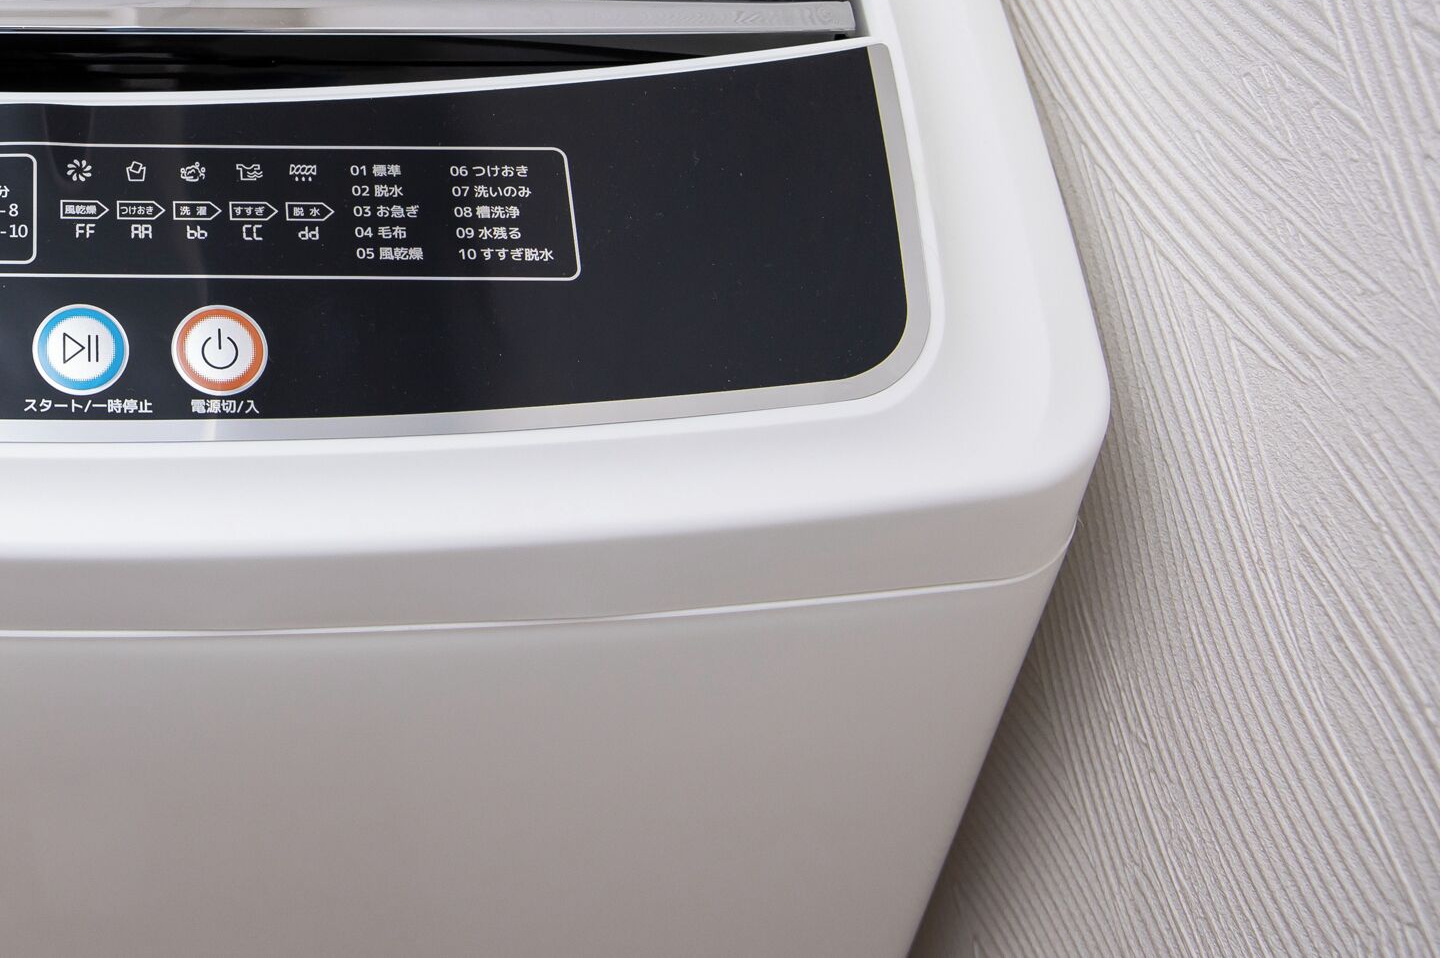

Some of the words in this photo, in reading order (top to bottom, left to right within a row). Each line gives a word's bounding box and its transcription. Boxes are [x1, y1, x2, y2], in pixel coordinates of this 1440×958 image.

[350, 164, 367, 176] 01
[372, 164, 402, 177] 標準
[450, 165, 469, 177] 06
[472, 165, 529, 178] つけおき
[351, 185, 370, 197] 02
[374, 185, 404, 198] 脱水
[451, 186, 470, 198] 07
[474, 186, 532, 198] 洗いのみ
[64, 204, 98, 216] 風乾燥
[119, 205, 154, 216] つけおき
[233, 205, 266, 217] すすぎ
[353, 205, 372, 217] 03
[376, 205, 420, 218] お急ぎ
[454, 206, 473, 218] 08
[476, 206, 520, 219] 槽洗浄
[75, 224, 96, 239] FF
[186, 225, 208, 240] bb
[242, 225, 263, 241] CC
[298, 226, 320, 241] dd
[354, 226, 373, 238] 04
[377, 226, 407, 239] 毛布
[456, 227, 475, 239] 09
[478, 227, 522, 240] 水残る
[356, 247, 375, 259] 05
[379, 247, 424, 261] 風乾燥
[459, 248, 477, 260] 10
[480, 248, 554, 261] すすぎ脱水
[23, 398, 153, 414] スタート/一時停止
[190, 398, 260, 414] 電源切/入
